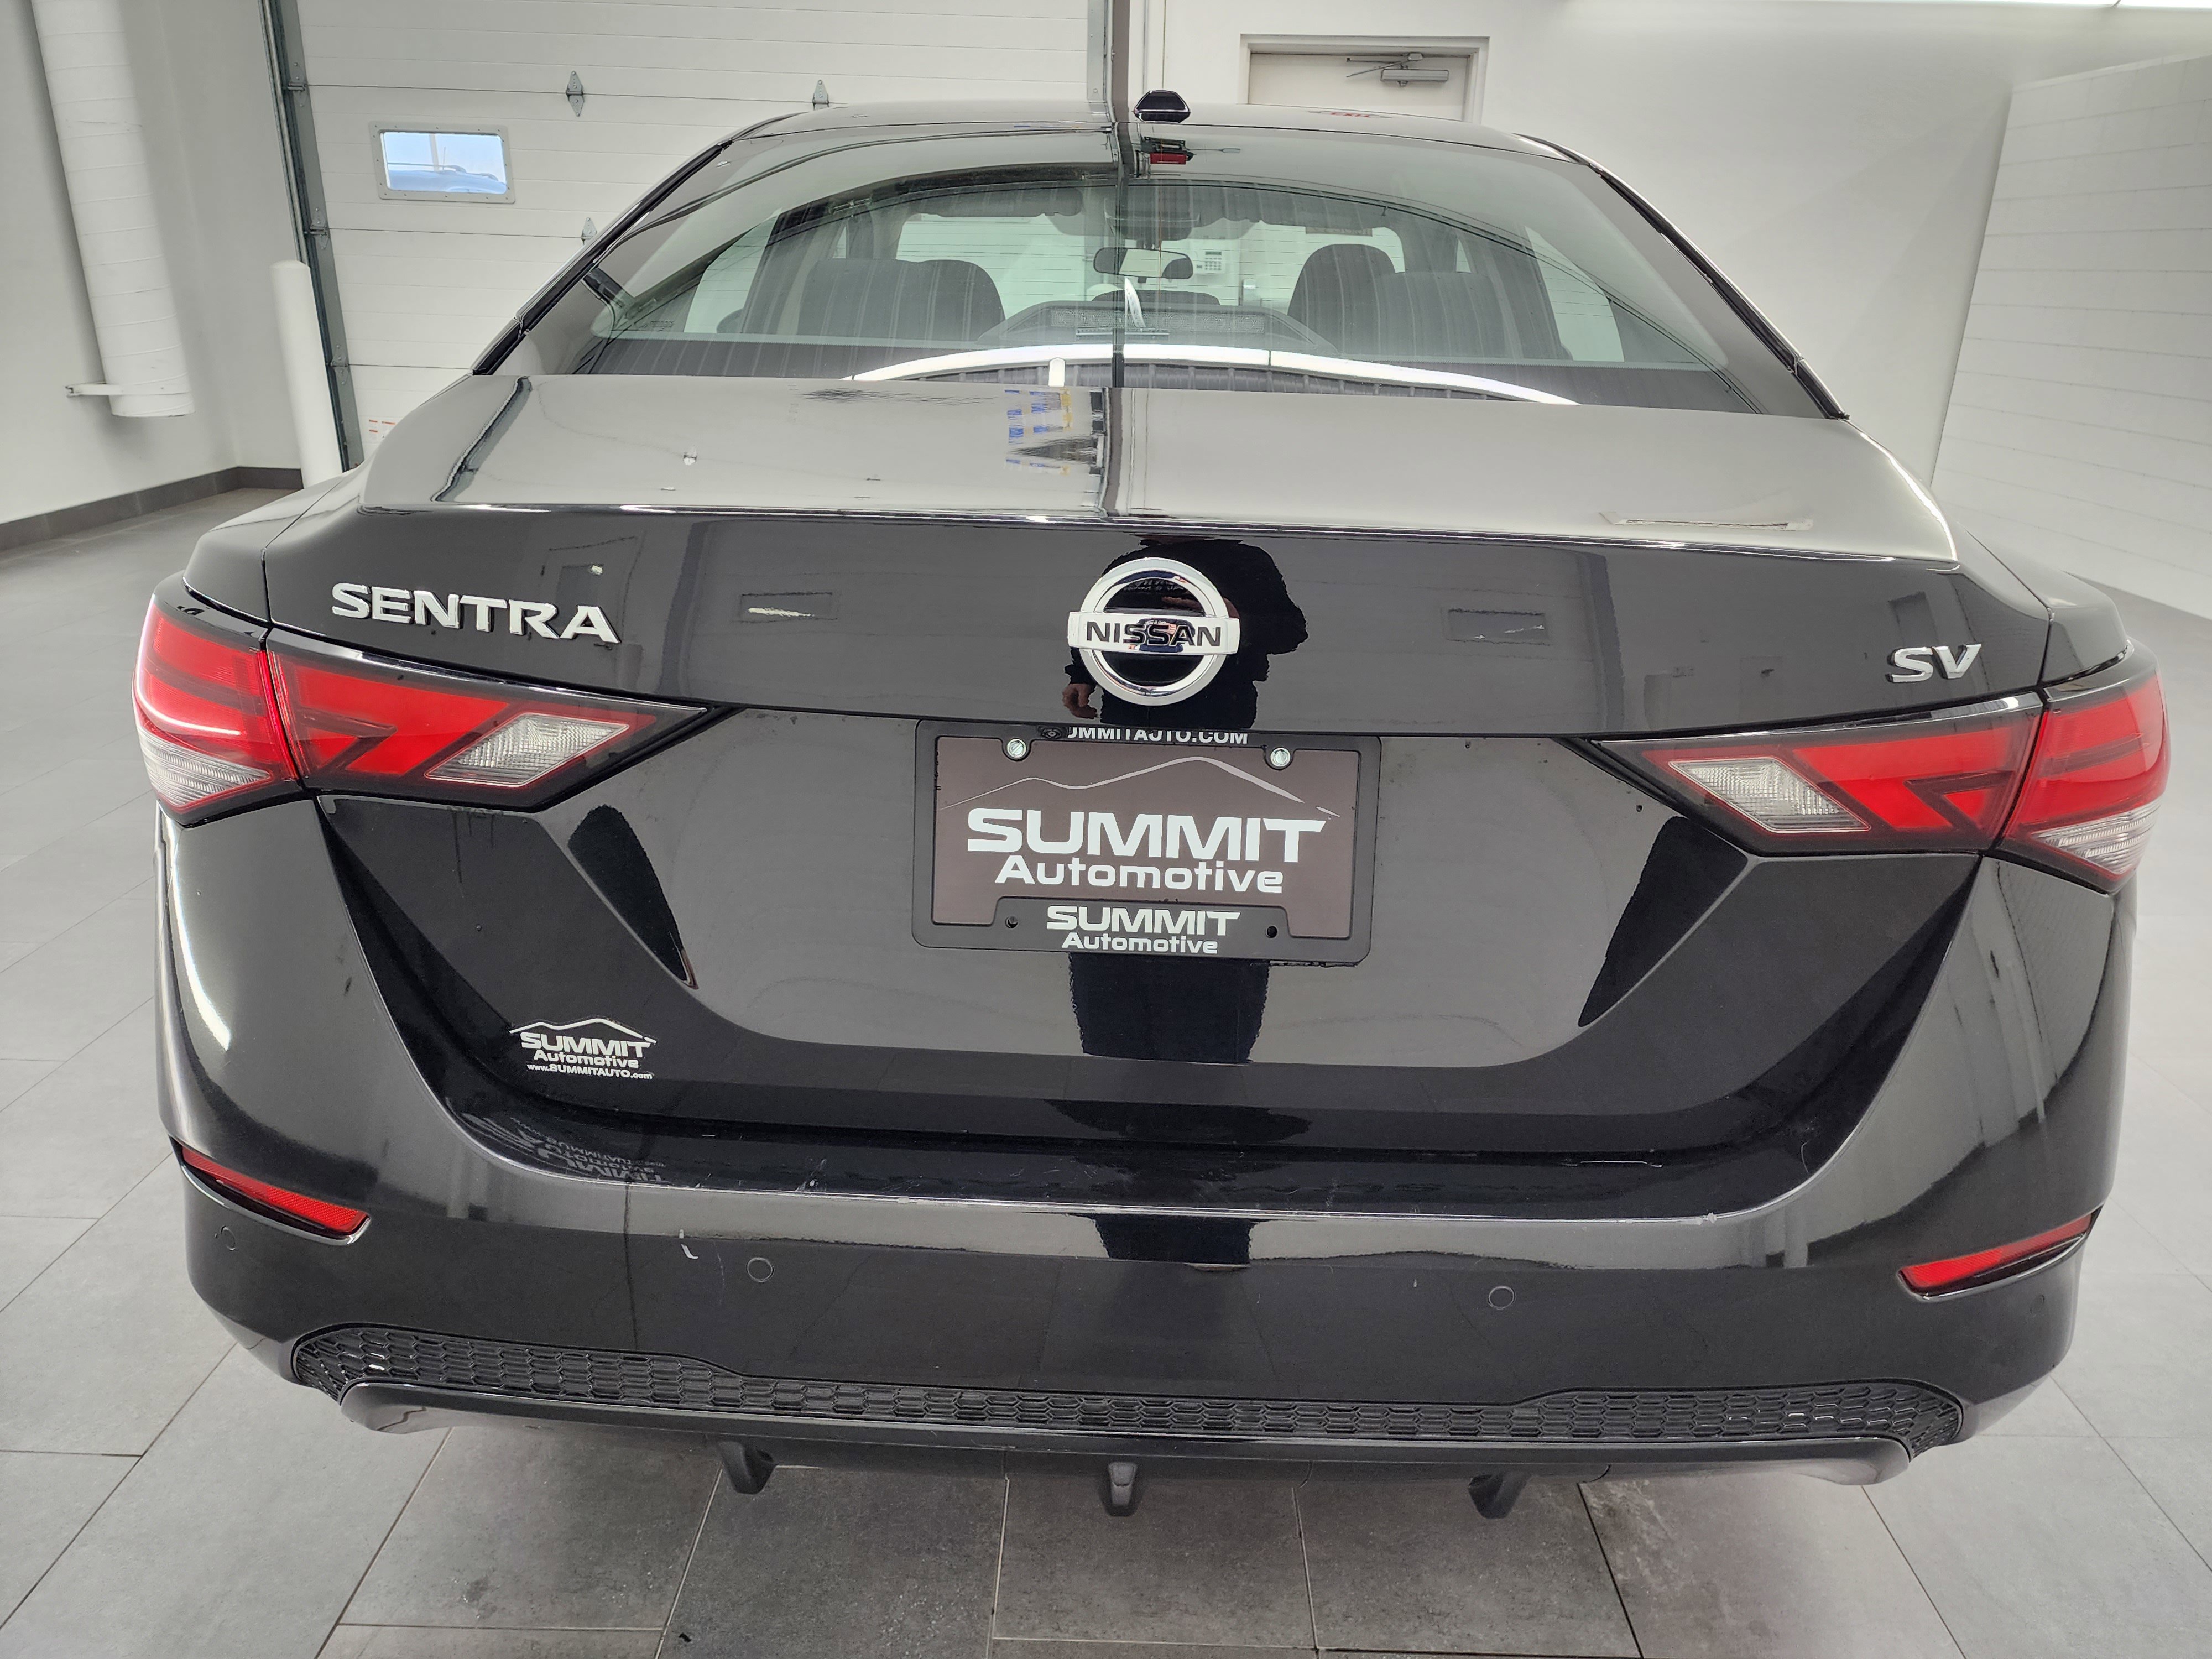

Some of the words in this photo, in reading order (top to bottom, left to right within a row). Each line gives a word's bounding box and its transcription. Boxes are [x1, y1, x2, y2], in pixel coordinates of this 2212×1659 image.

[332, 582, 621, 644] SENTRA
[1086, 621, 1221, 646] NISSAN
[1886, 643, 1982, 682] SV
[967, 808, 1327, 863] SUMMIT
[995, 855, 1284, 894] Automotive
[1047, 905, 1241, 936] SUMMIT
[1061, 932, 1218, 954] Automotive
[520, 1032, 651, 1058] SUMMIT
[533, 1049, 639, 1068] Automotive
[526, 1063, 653, 1079] www.SUMMITAUTO.com
